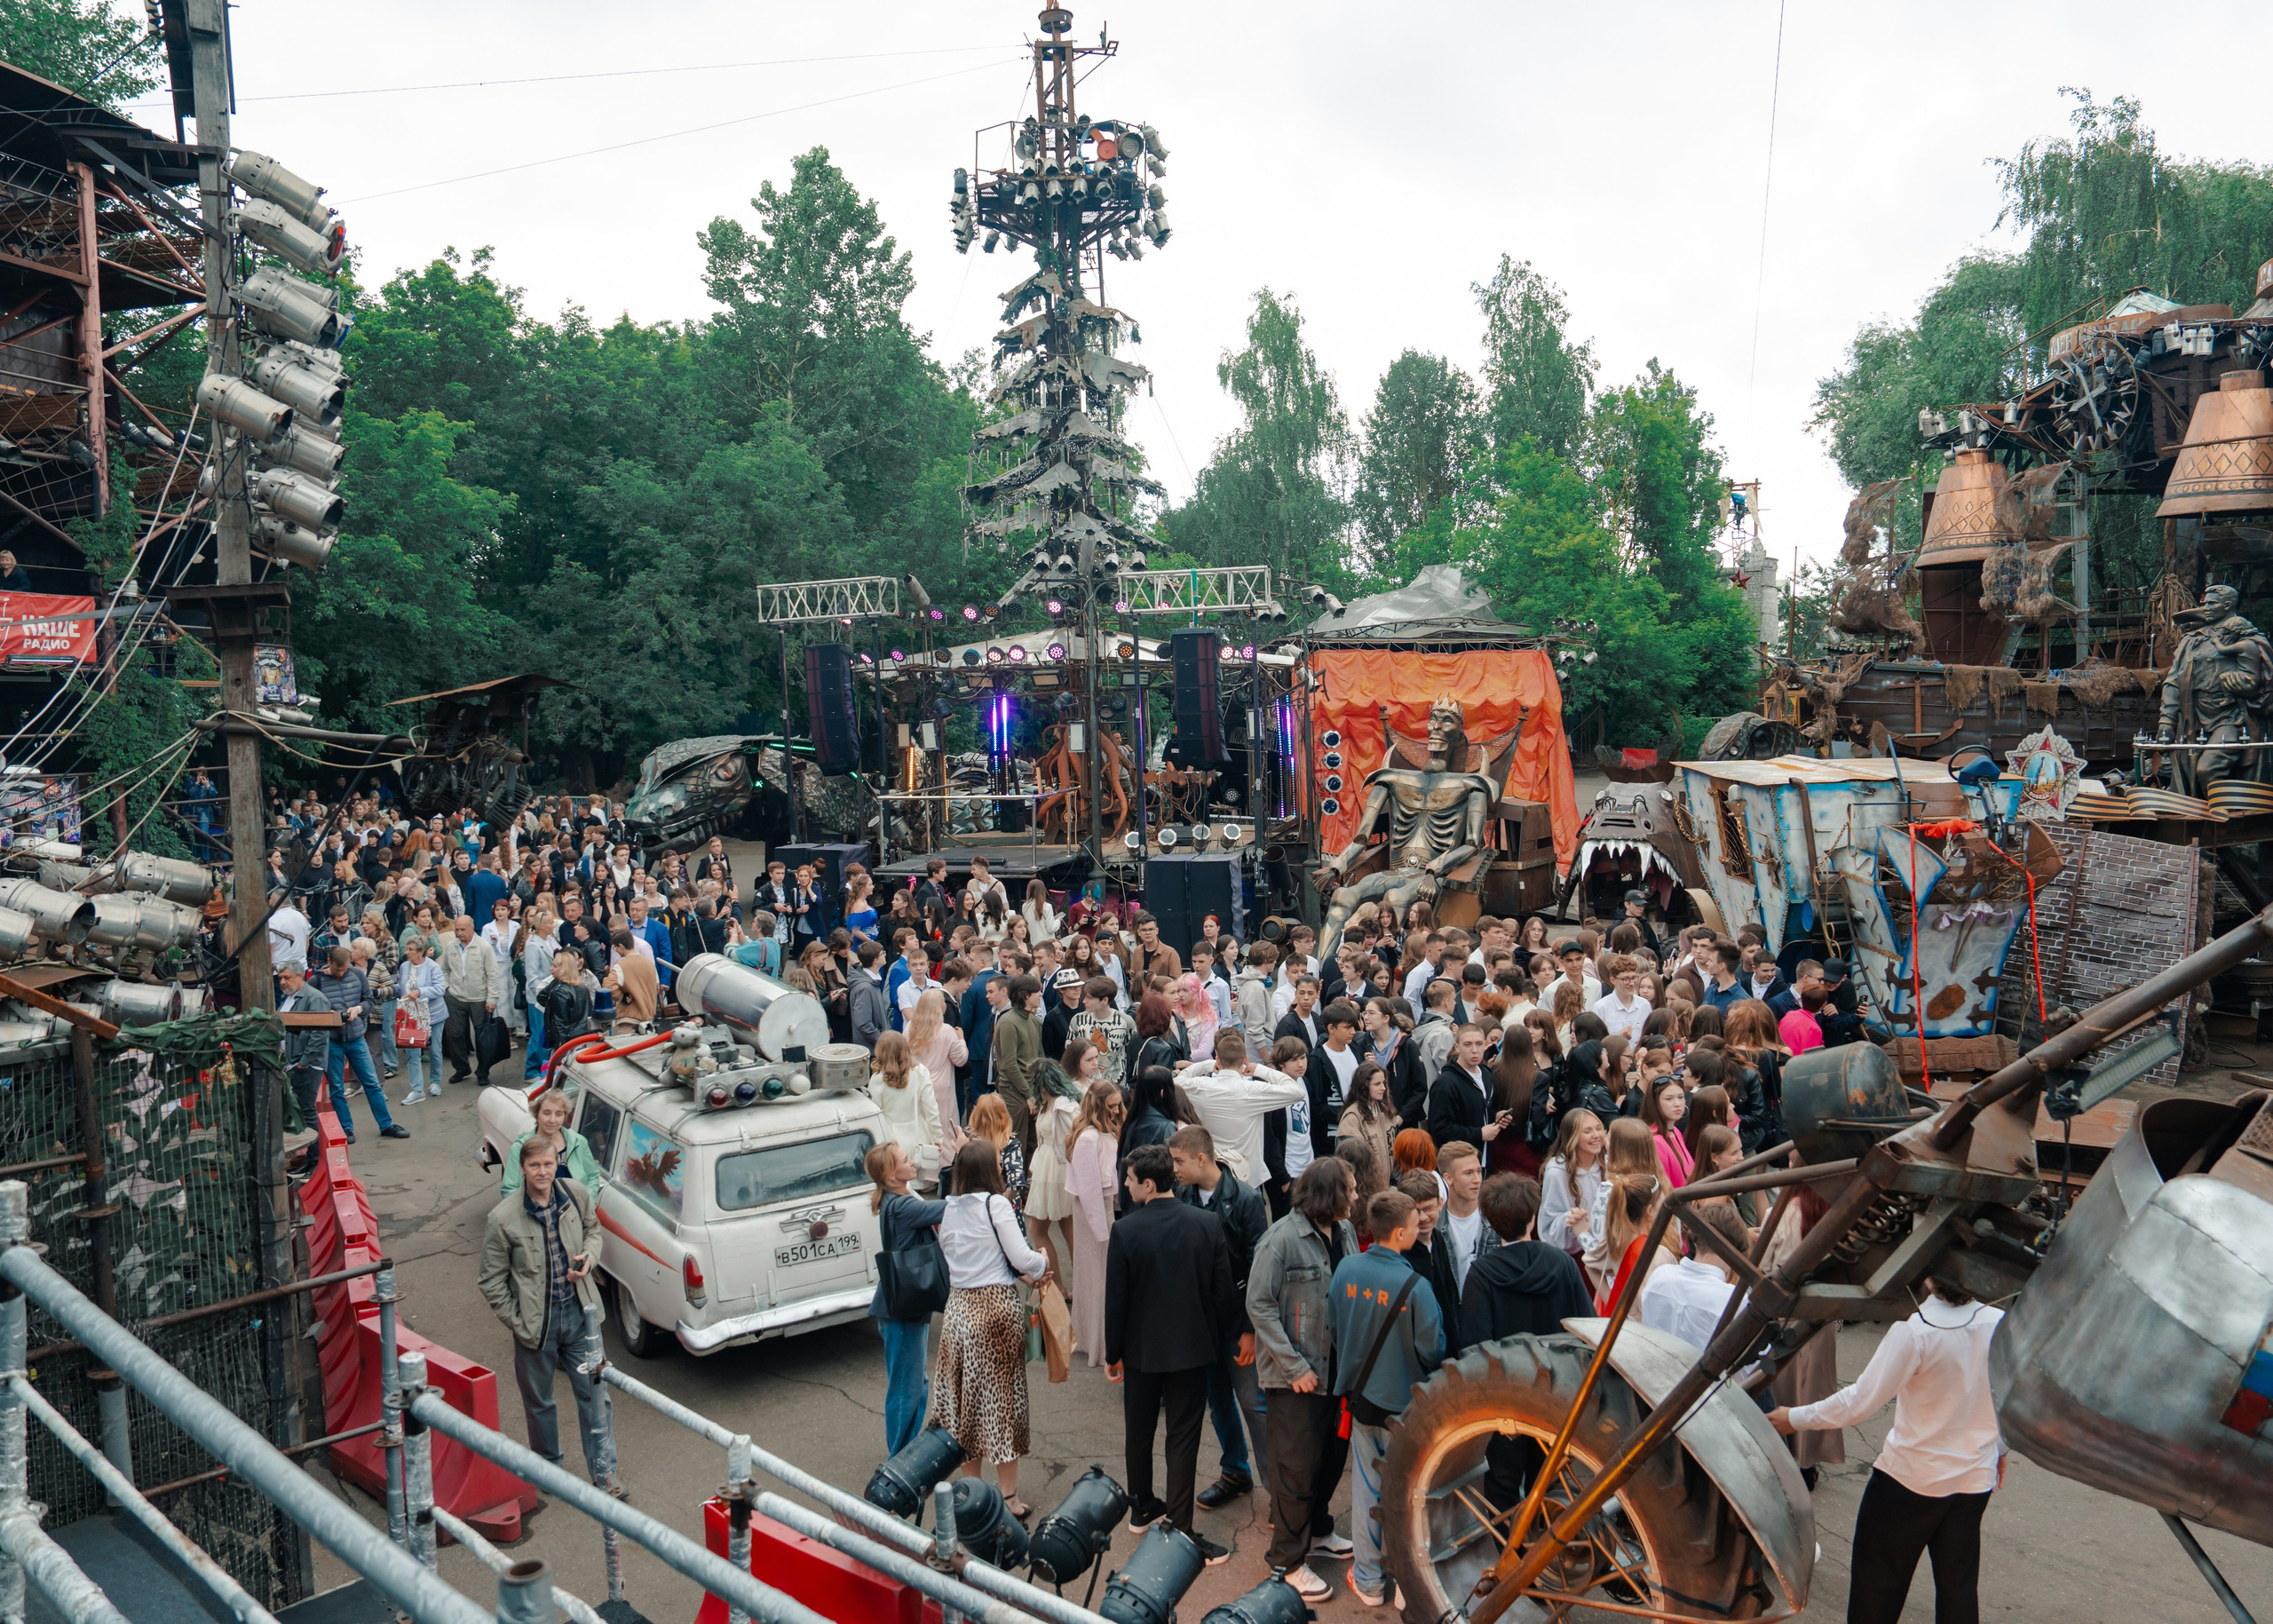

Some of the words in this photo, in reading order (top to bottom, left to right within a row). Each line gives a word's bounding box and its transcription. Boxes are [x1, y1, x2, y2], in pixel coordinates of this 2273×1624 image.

[22, 614, 81, 638] НАШЕ
[23, 638, 70, 651] РАДИО
[837, 1234, 857, 1248] 199
